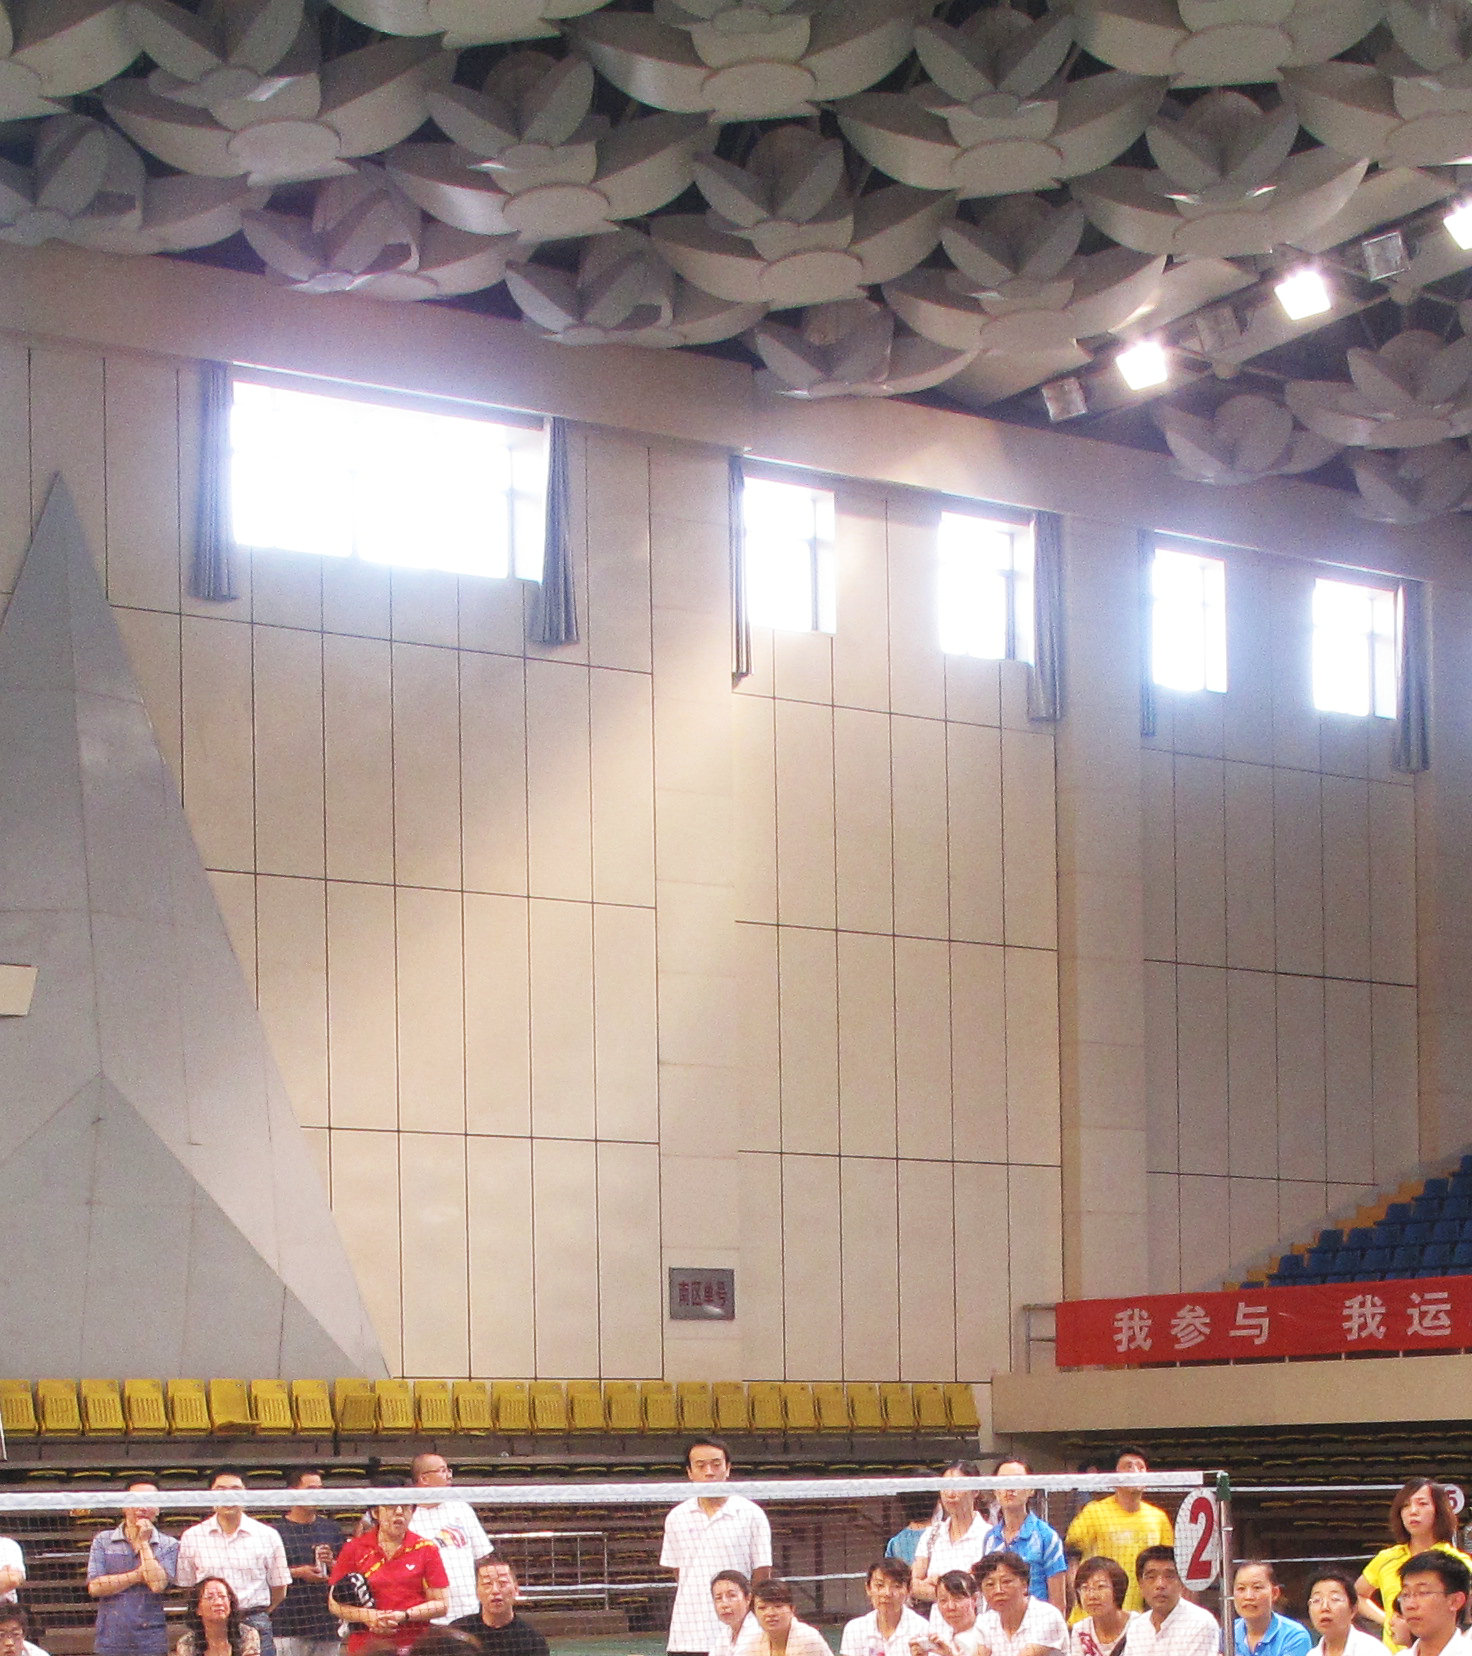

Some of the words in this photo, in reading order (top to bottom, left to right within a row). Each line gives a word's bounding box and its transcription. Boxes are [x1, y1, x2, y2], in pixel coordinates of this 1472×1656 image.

[1112, 1301, 1270, 1354] 我参与
[1186, 1496, 1214, 1580] 2
